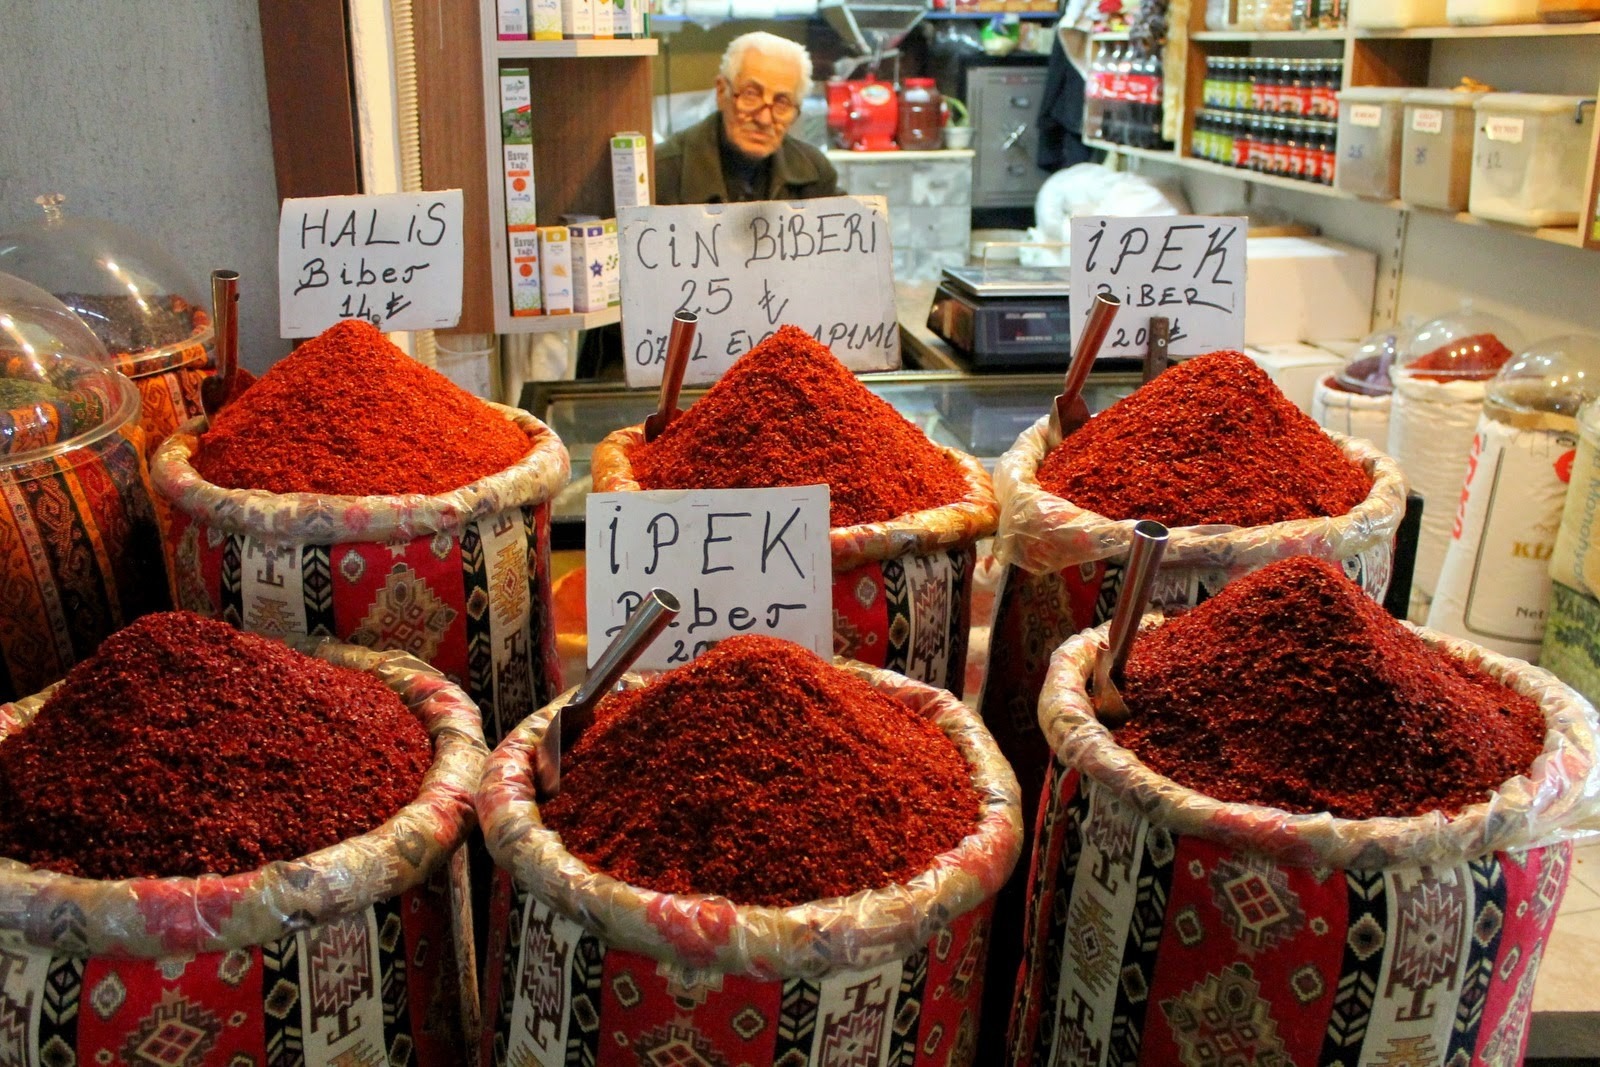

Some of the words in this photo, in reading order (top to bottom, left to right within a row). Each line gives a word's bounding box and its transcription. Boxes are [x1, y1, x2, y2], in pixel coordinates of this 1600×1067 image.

[293, 257, 430, 296] Biber
[675, 277, 733, 316] 25
[635, 329, 708, 366] ÖZL
[605, 587, 807, 637] Bber
